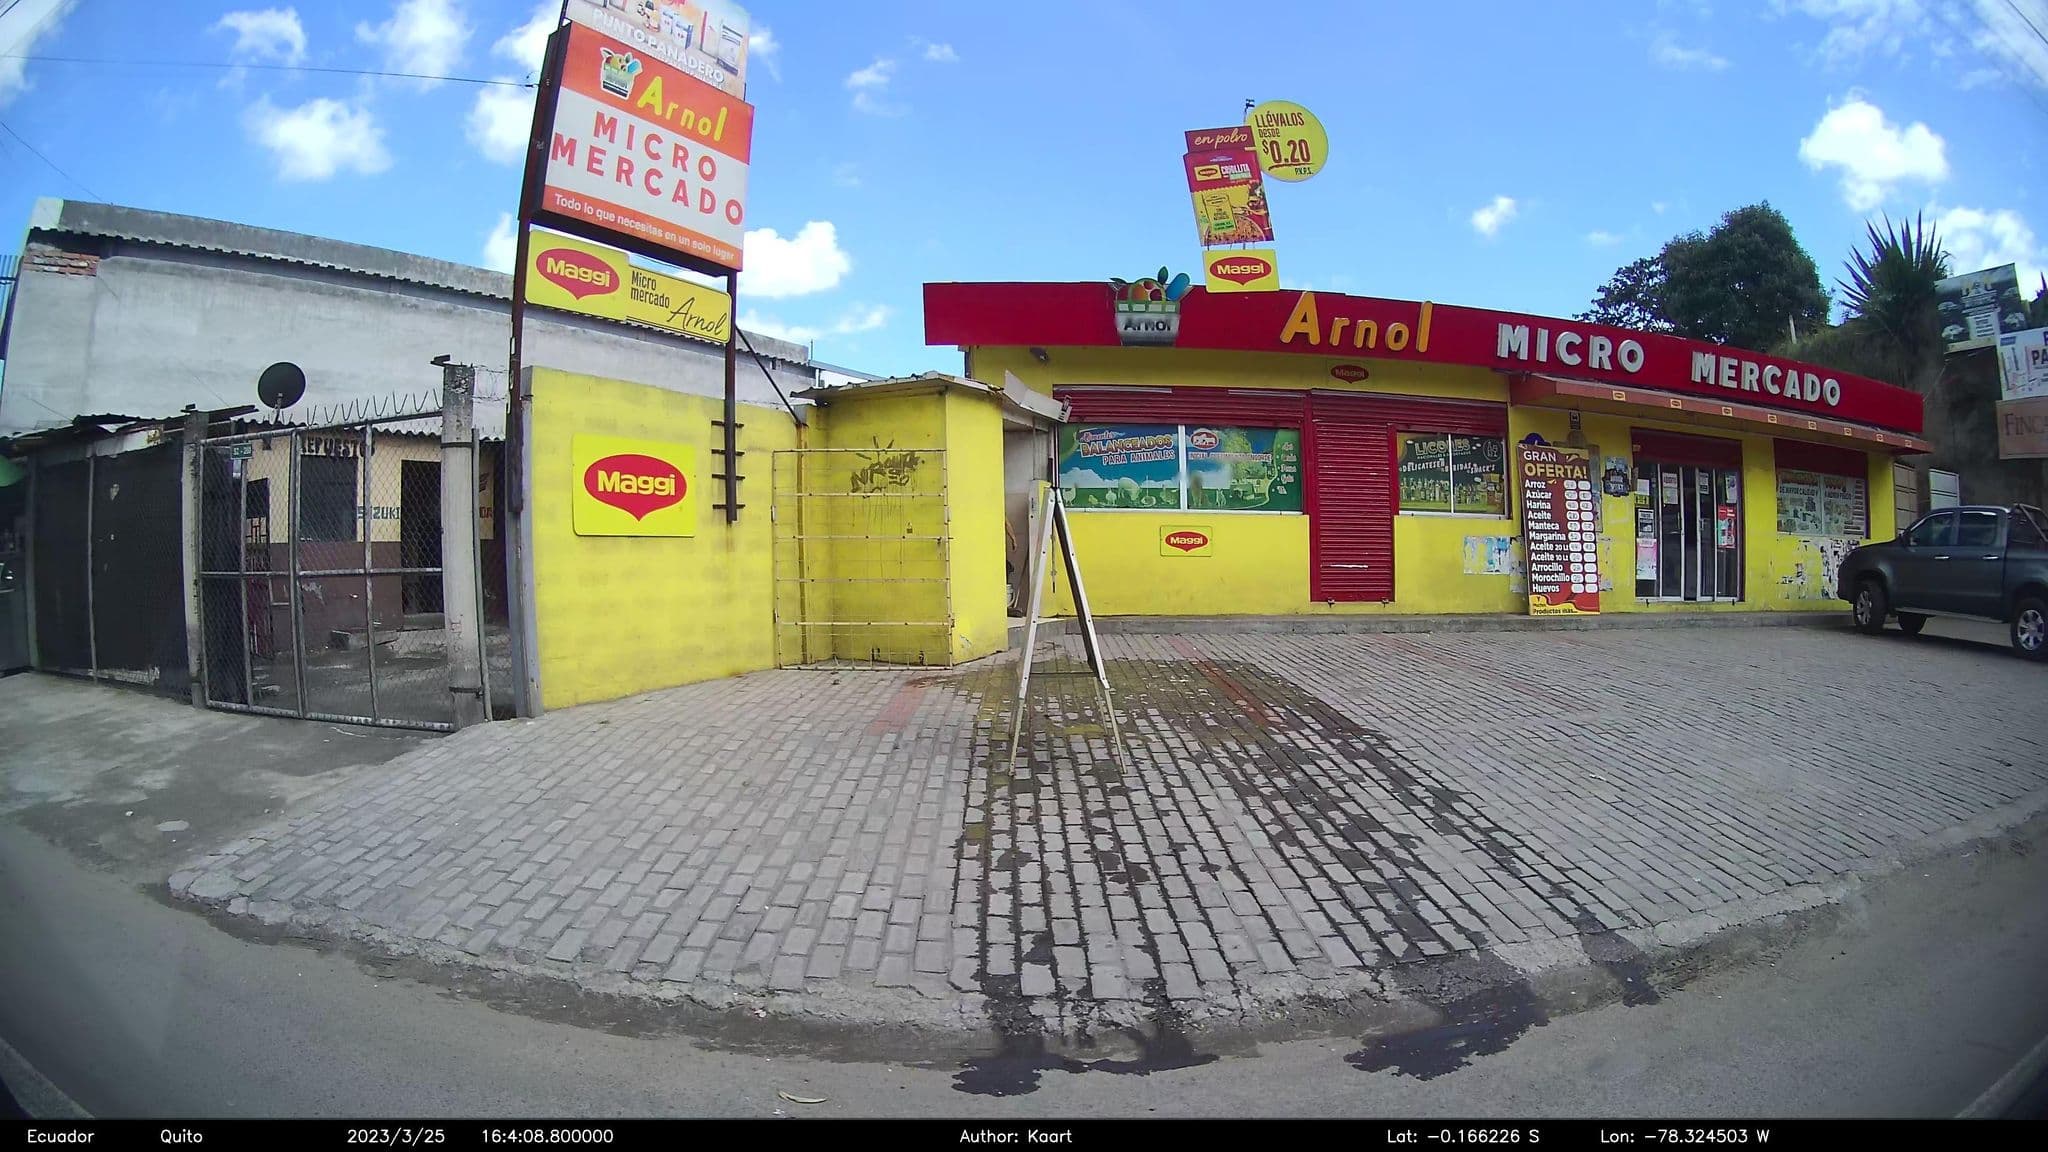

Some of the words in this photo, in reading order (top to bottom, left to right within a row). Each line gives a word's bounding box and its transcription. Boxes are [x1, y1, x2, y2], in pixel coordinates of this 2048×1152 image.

[592, 9, 646, 43] PUNTO
[649, 35, 726, 84] PANADERO
[637, 76, 728, 141] Arnol
[594, 111, 717, 182] MICRO
[1194, 135, 1214, 146] en
[1214, 128, 1248, 149] polvo
[1262, 139, 1311, 164] $0.20
[551, 132, 743, 225] MERCADO
[554, 193, 582, 212] Todo
[583, 202, 594, 215] lo
[596, 208, 616, 223] que
[617, 215, 664, 239] necesitas
[664, 230, 677, 243] en
[678, 236, 691, 248] un
[692, 239, 712, 255] solo
[546, 257, 611, 287] Maggi
[1216, 263, 1265, 275] Maggi
[631, 270, 657, 291] Micro
[630, 287, 670, 309] mercado
[666, 297, 728, 336] Arnol
[1280, 290, 1434, 353] Arnol
[1496, 322, 1645, 374] MICRO
[1691, 351, 1841, 407] MERCADO
[1080, 434, 1173, 458] BALANCEADOS
[1103, 454, 1127, 465] PARA
[1130, 449, 1175, 463] ANIMALES
[1523, 450, 1557, 462] GRAN
[1524, 462, 1588, 480] OFERTA!
[597, 470, 676, 496] Maggi
[1525, 479, 1546, 489] Arroz
[357, 506, 400, 520] SZUKI
[1526, 500, 1551, 509] Harina
[1528, 510, 1552, 519] Aceite
[1528, 521, 1560, 530] Manteca
[1170, 535, 1204, 545] Maggi
[1529, 531, 1566, 542] Margarina
[1530, 542, 1554, 551] Aceite
[1531, 552, 1555, 561] Aceite
[1531, 562, 1563, 572] Arrocillo
[1531, 573, 1570, 582] Morochillo
[1533, 583, 1560, 593] Huevos
